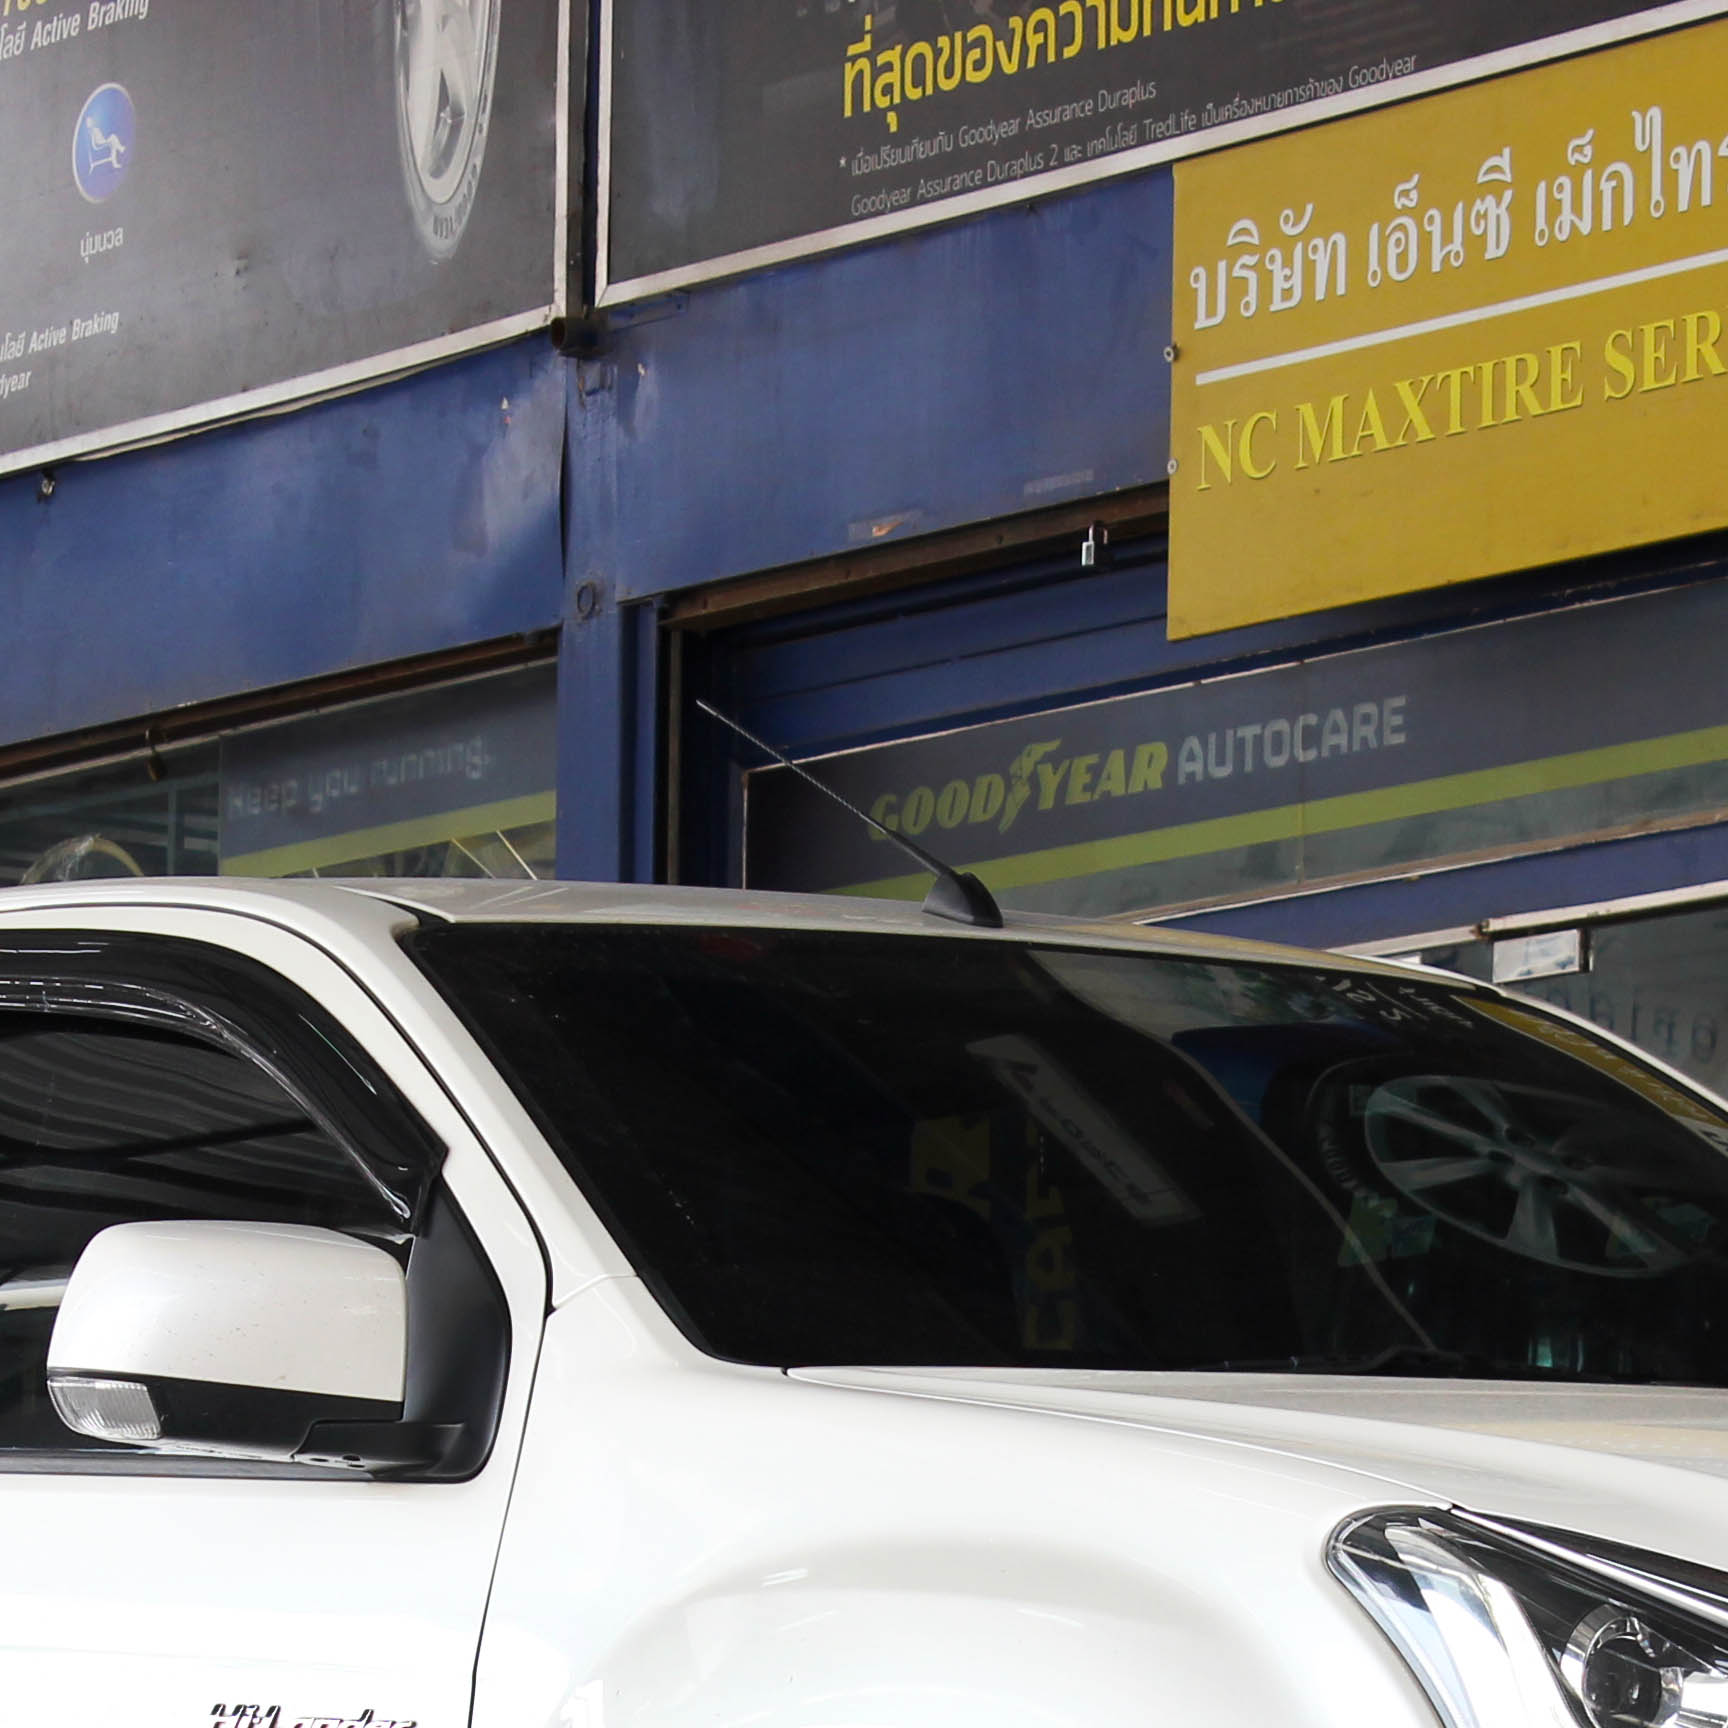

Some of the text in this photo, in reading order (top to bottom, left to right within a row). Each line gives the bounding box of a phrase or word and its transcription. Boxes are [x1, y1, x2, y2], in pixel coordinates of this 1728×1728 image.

[29, 13, 81, 51] Active
[850, 185, 912, 217] Goodyear
[916, 165, 983, 200] Assurance
[987, 150, 1045, 183] Duraplus
[1048, 144, 1059, 166] 2
[1143, 112, 1197, 142] TredLife
[1348, 55, 1417, 90] Goodyear
[958, 115, 1021, 148] Goodyear
[1025, 98, 1094, 132] Assurance
[1098, 79, 1157, 113] Duraplus
[1190, 203, 1346, 331] บริษัท
[1367, 146, 1515, 287] เอ็นซี
[28, 325, 67, 355] Active
[71, 311, 120, 342] Braking
[1197, 410, 1278, 491] NC
[1293, 340, 1584, 471] MAXTIRE
[870, 695, 1407, 842] GOODYEAR AUTOCARE
